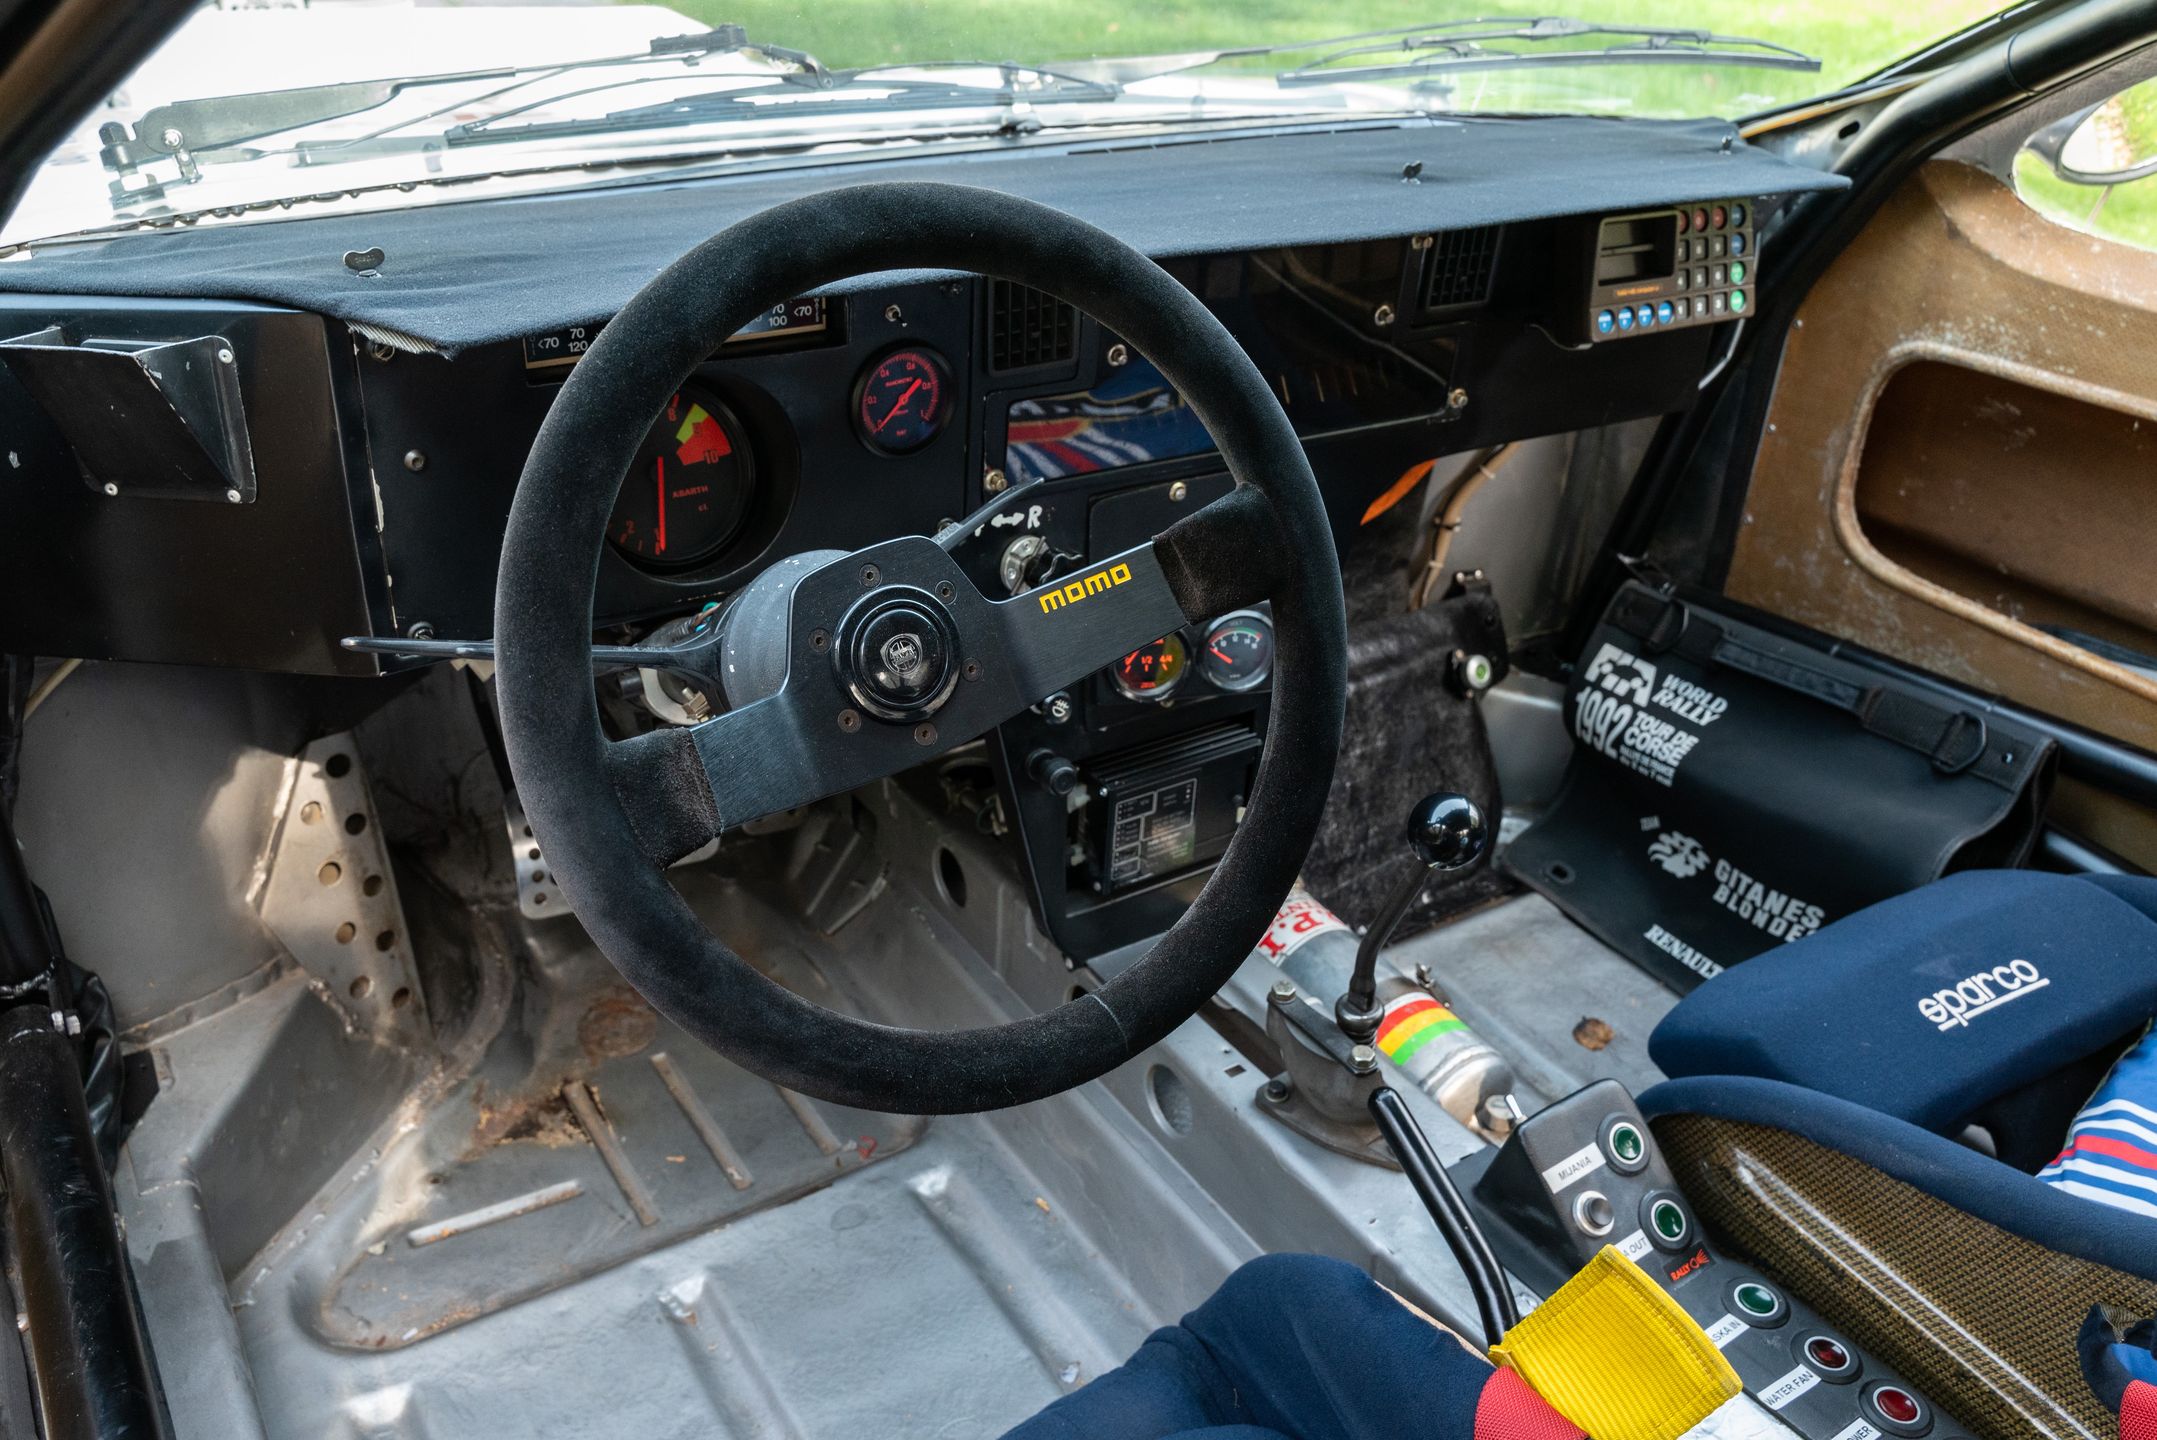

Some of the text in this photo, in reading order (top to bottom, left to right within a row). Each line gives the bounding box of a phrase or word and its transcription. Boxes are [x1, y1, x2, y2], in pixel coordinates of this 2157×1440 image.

[768, 315, 788, 327] 100
[793, 305, 812, 317] <70
[537, 336, 560, 350] <70
[567, 340, 589, 353] 120
[569, 327, 585, 340] 70
[672, 485, 709, 498] ABARTH
[1027, 504, 1043, 529] R
[1039, 562, 1132, 614] momo
[1651, 688, 1722, 727] RALLY
[1661, 673, 1729, 714] WORLD
[1575, 686, 1634, 760] 1992
[1632, 709, 1700, 753] TOUR DE
[1623, 725, 1688, 768] CORSE
[1713, 857, 1826, 930] GITANES
[1643, 923, 1726, 981] RENAULT
[1918, 959, 2042, 1029] sparco
[1628, 1236, 1648, 1254] OUT
[1670, 1264, 1691, 1282] RALLY
[1765, 1370, 1814, 1407] WATER FAN
